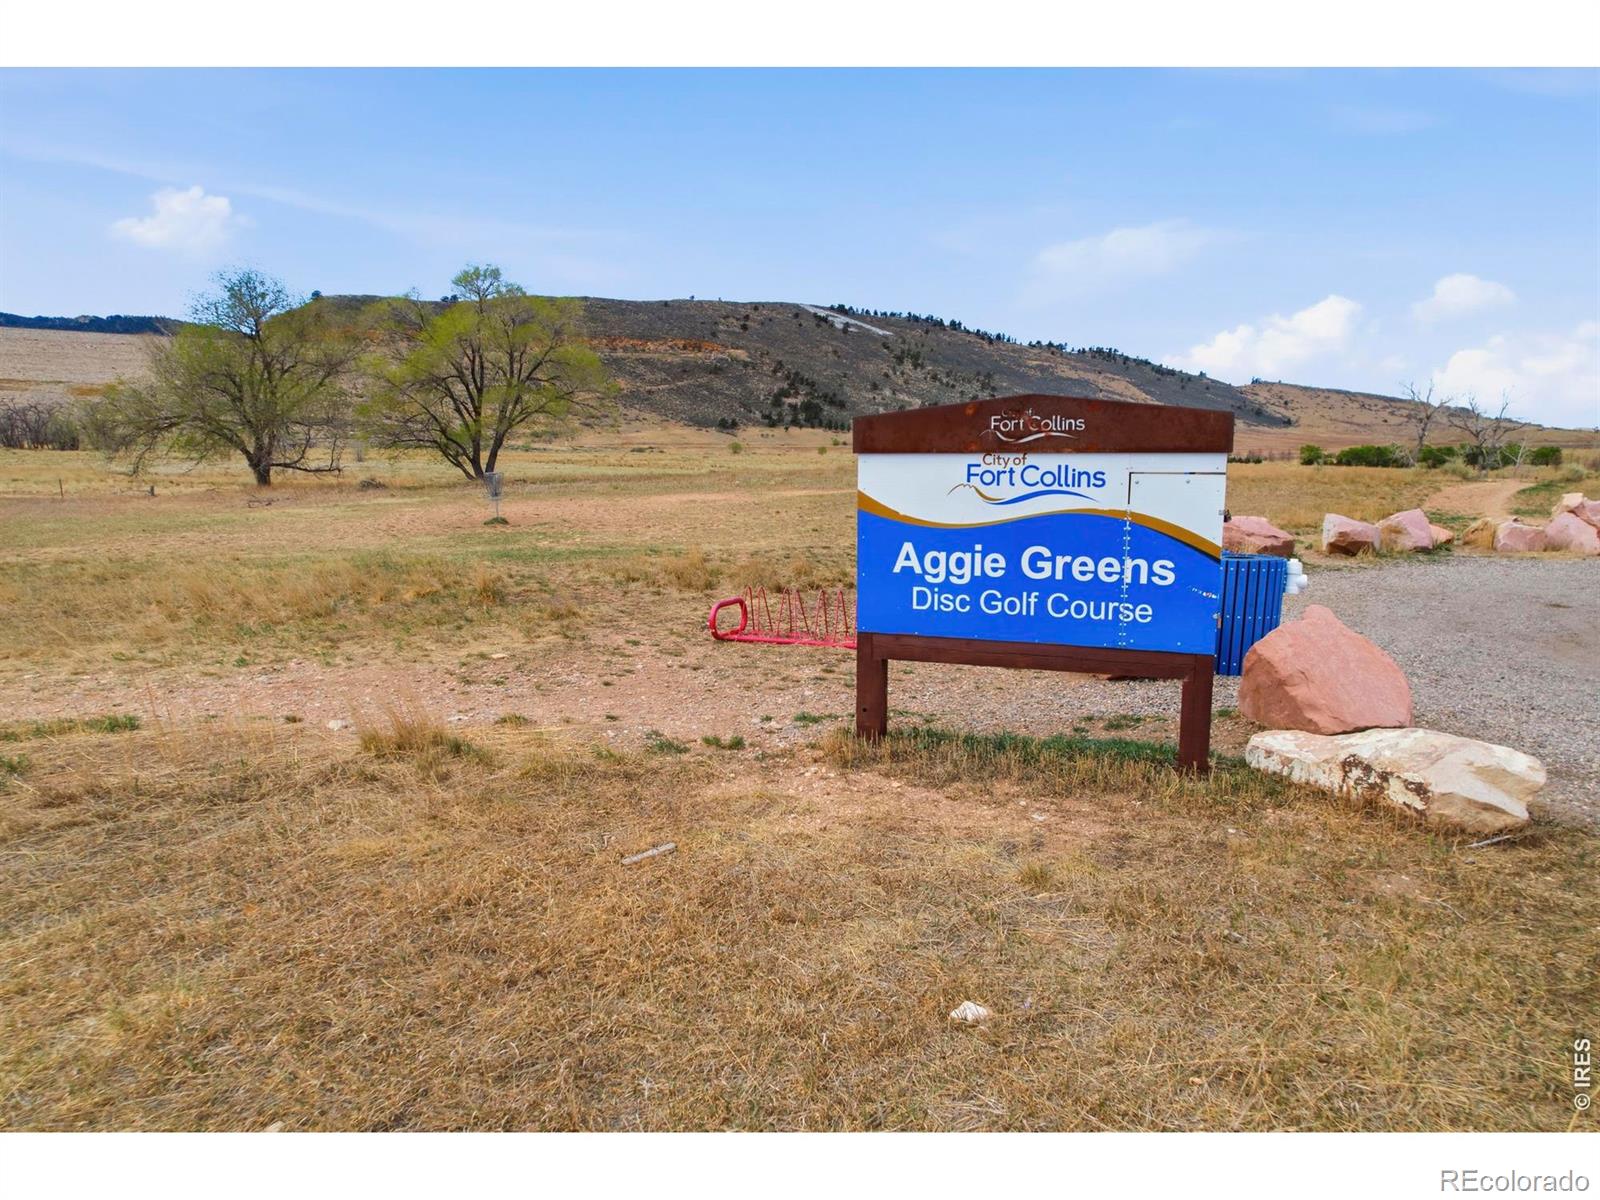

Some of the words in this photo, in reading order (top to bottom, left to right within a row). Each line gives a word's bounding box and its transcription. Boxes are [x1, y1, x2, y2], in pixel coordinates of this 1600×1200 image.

[991, 416, 1024, 431] Fort
[1028, 415, 1085, 431] Collins
[982, 453, 1010, 468] City
[1013, 453, 1027, 465] of
[967, 464, 1015, 486] Fort
[1020, 464, 1106, 488] Collins
[893, 541, 1006, 584] Aggie
[1021, 546, 1176, 586] Greens
[912, 587, 970, 613] Disc
[980, 590, 1039, 616] Golf
[1047, 593, 1153, 623] Course
